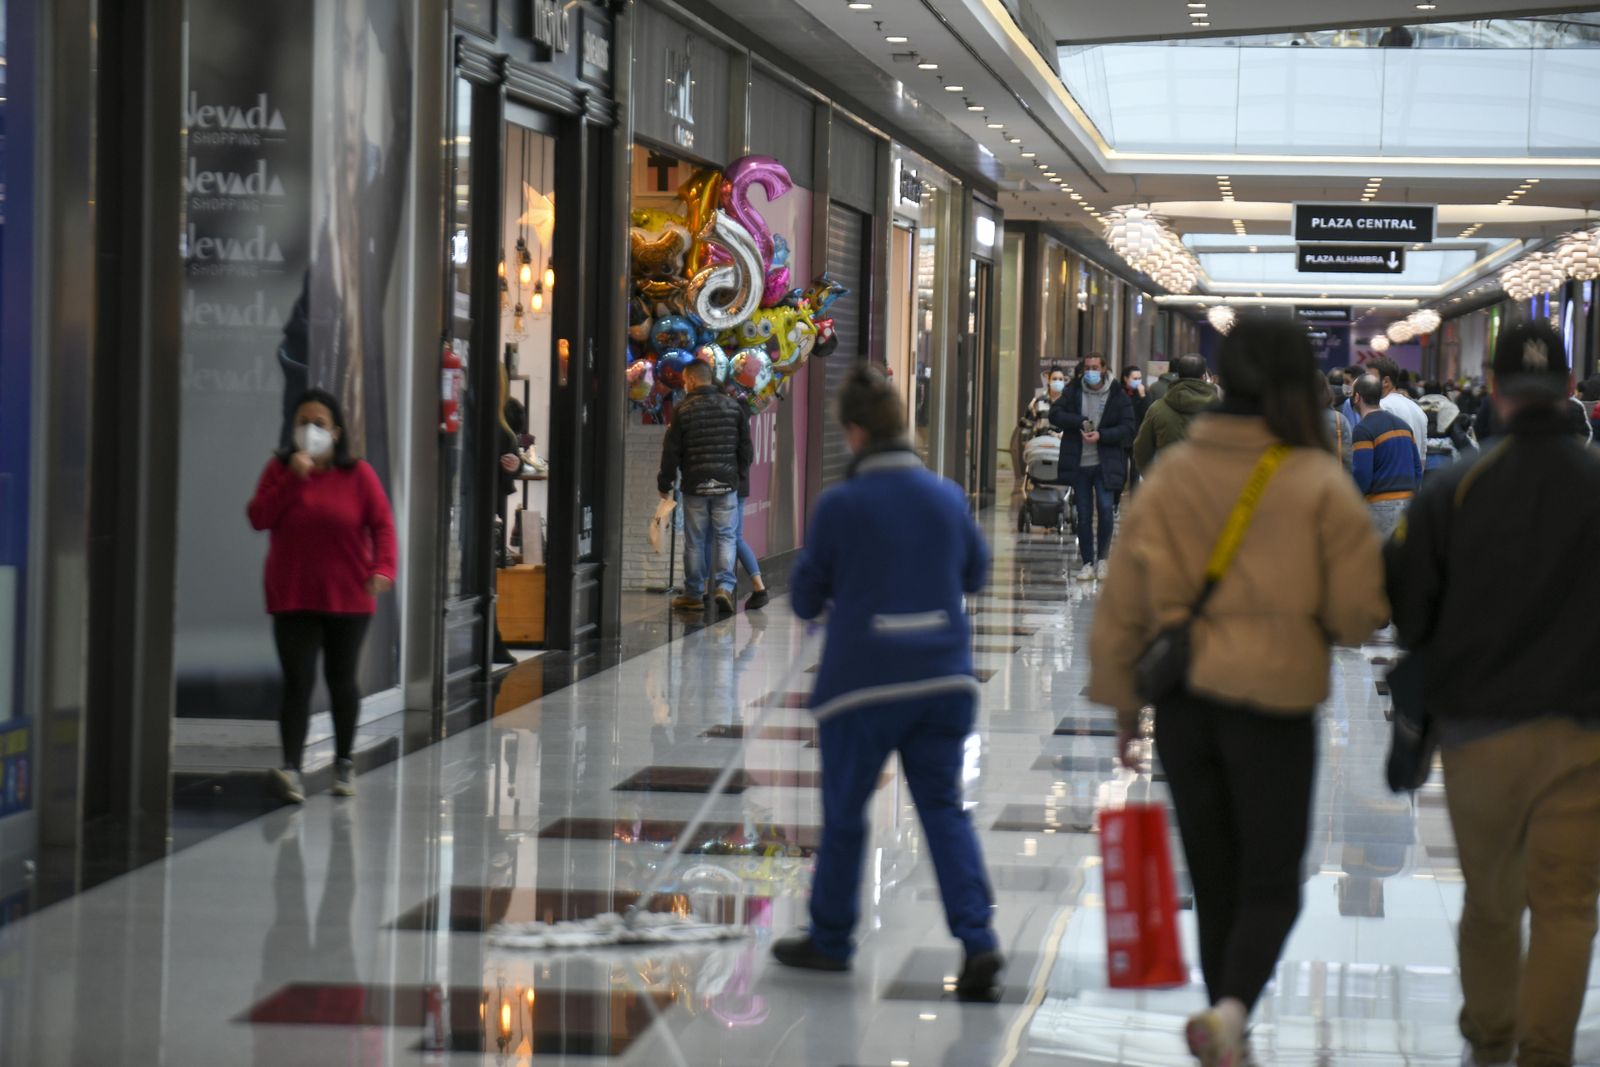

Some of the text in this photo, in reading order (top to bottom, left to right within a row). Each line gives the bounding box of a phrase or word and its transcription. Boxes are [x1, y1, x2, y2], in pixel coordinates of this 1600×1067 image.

[193, 132, 260, 145] SHOPPING
[192, 197, 260, 211] SHOPPING
[1311, 217, 1417, 230] PLAZA CENTRAL
[1305, 254, 1385, 264] PLAZA ALHAMBRA
[749, 413, 777, 465] OVE
